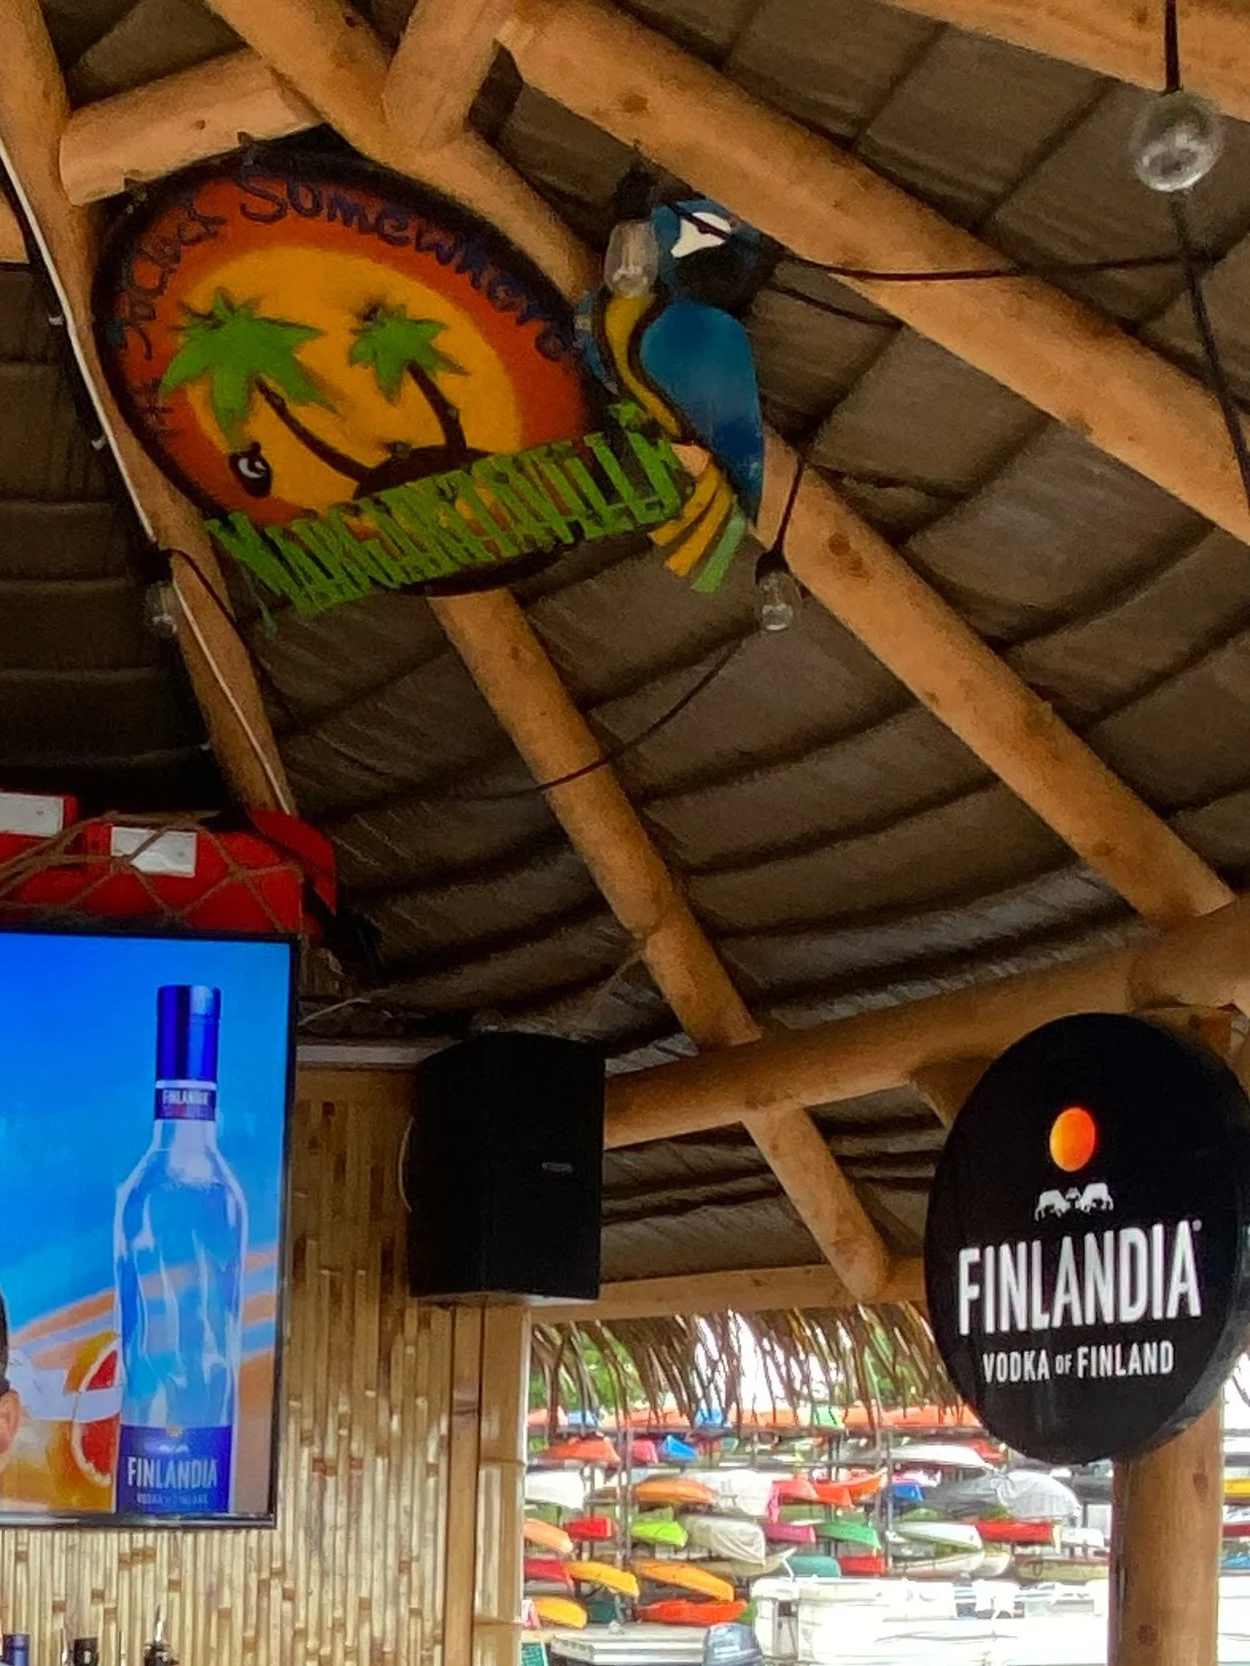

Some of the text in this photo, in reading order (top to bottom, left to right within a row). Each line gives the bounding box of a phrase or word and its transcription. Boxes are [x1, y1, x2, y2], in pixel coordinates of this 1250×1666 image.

[958, 1220, 1202, 1336] FINLANDIA
[983, 1341, 1175, 1383] VODKA OF FINLAND
[127, 1456, 219, 1489] FINLANDIA
